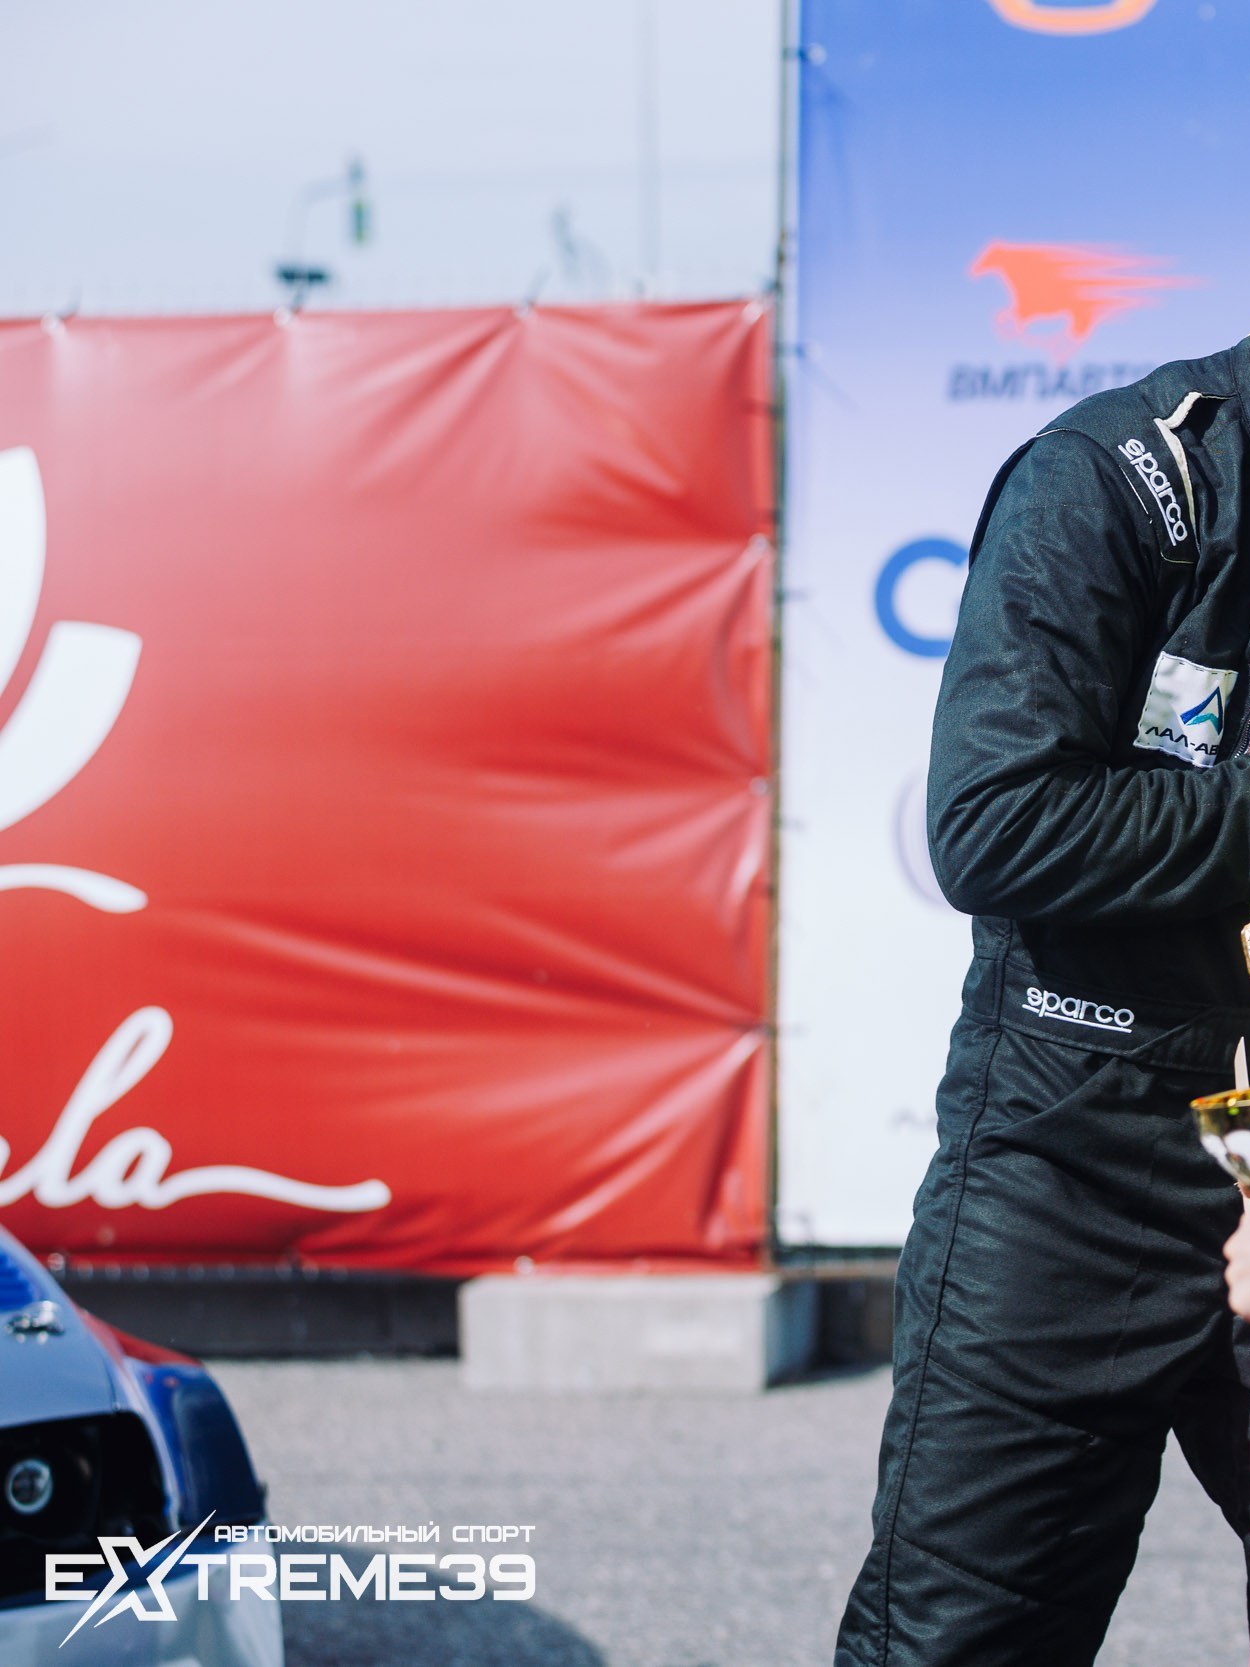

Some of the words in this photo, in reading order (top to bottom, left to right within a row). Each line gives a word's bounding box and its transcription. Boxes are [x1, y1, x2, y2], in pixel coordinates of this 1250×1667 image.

[1120, 439, 1188, 545] sparco
[1144, 726, 1221, 756] ЛАЛ-АВ
[1022, 987, 1135, 1032] sparco
[0, 1006, 391, 1212] la
